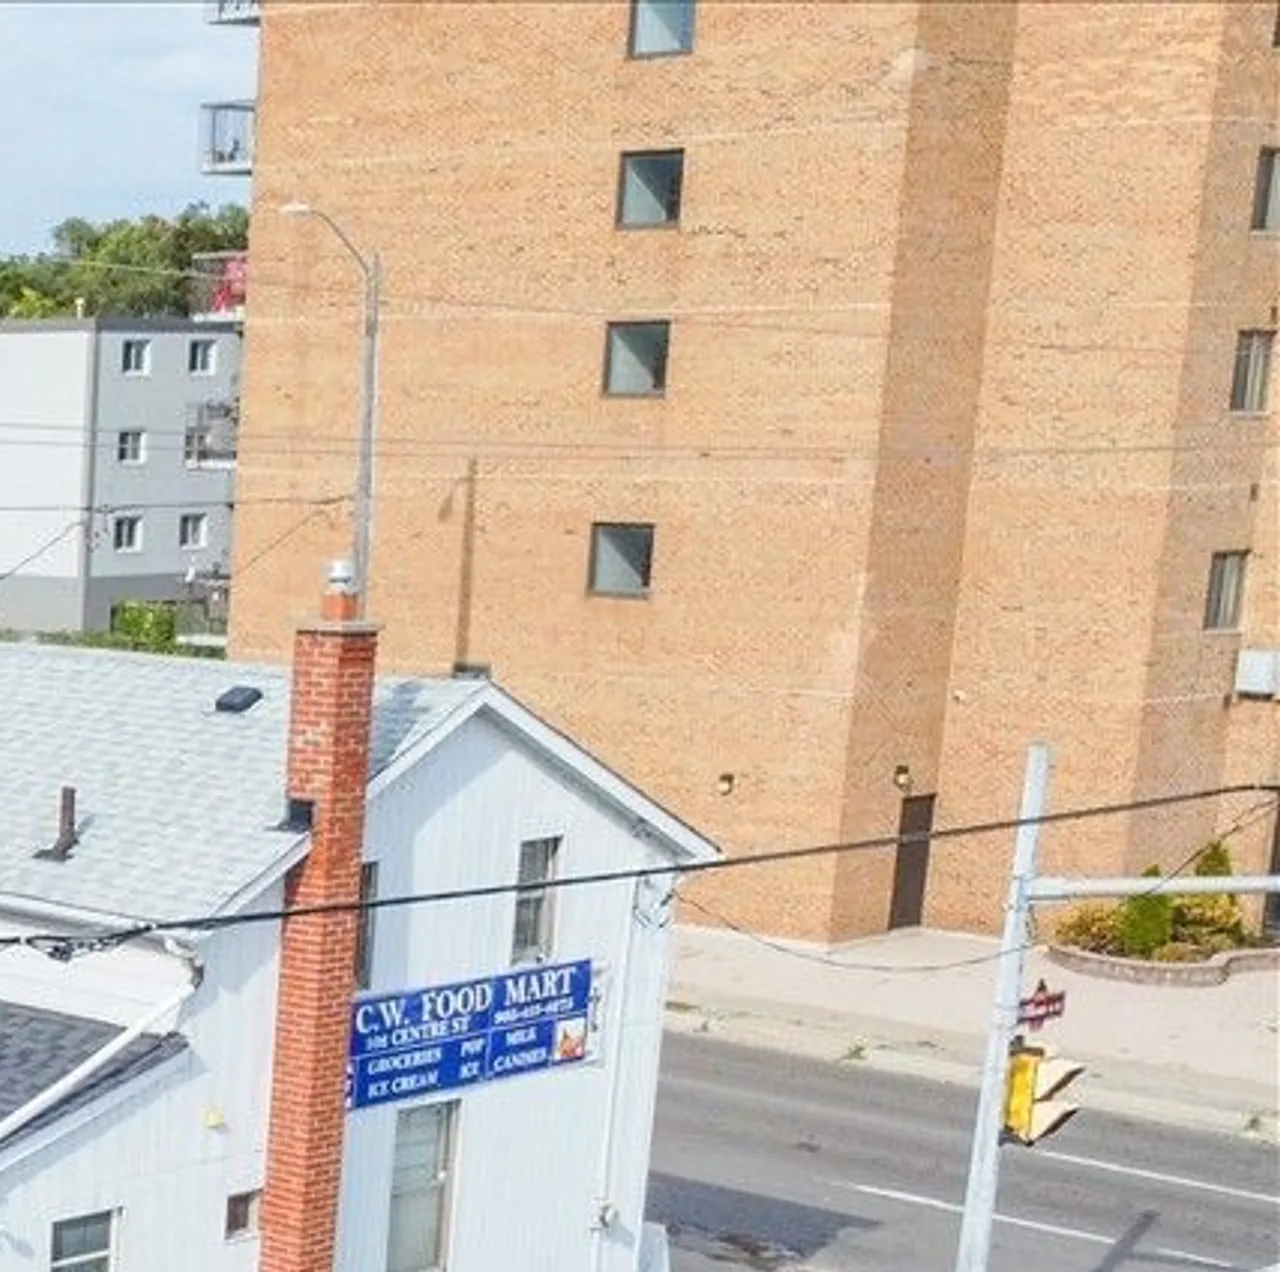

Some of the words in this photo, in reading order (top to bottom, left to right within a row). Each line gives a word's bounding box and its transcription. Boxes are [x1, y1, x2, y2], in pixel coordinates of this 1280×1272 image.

[420, 984, 492, 1021] FOOD
[504, 967, 576, 1005] MART
[391, 1020, 448, 1046] CENTRE
[506, 1027, 537, 1047] MILK
[460, 1038, 485, 1058] POP
[492, 1047, 548, 1074] CANDIES
[367, 1047, 442, 1076] GROCERIES
[460, 1062, 481, 1081] ICE
[367, 1080, 390, 1100] ICE
[392, 1071, 439, 1097] CREAM
